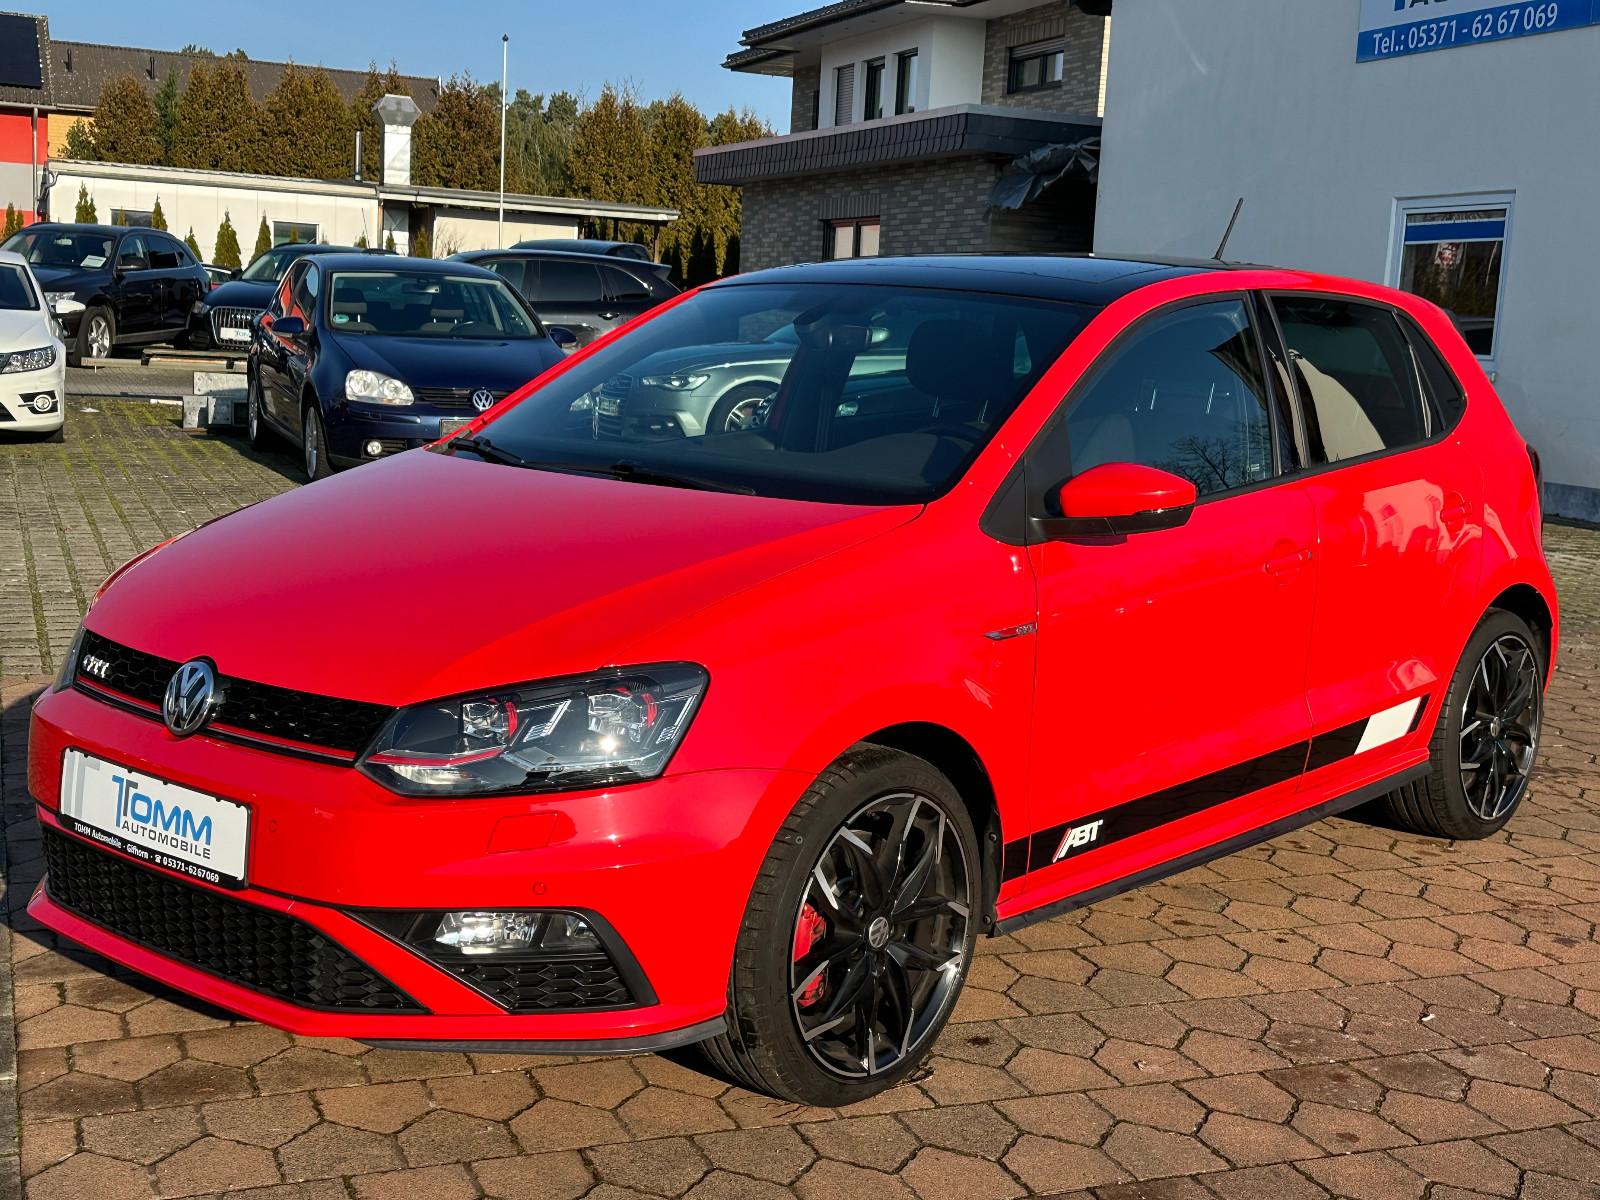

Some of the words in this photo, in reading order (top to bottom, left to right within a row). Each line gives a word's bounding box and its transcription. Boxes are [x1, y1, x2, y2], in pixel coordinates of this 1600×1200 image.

[1373, 32, 1404, 55] Tel.:
[1408, 19, 1457, 49] 05371
[1472, 13, 1493, 39] 62
[1497, 9, 1520, 34] 67
[1523, 3, 1558, 30] 069
[112, 774, 213, 846] TOMM
[74, 822, 91, 836] TOMM
[91, 829, 122, 848] Automobile
[162, 856, 219, 883] 05371-6267069
[121, 819, 211, 860] AUTOMOBILE
[1052, 819, 1104, 863] ABT
